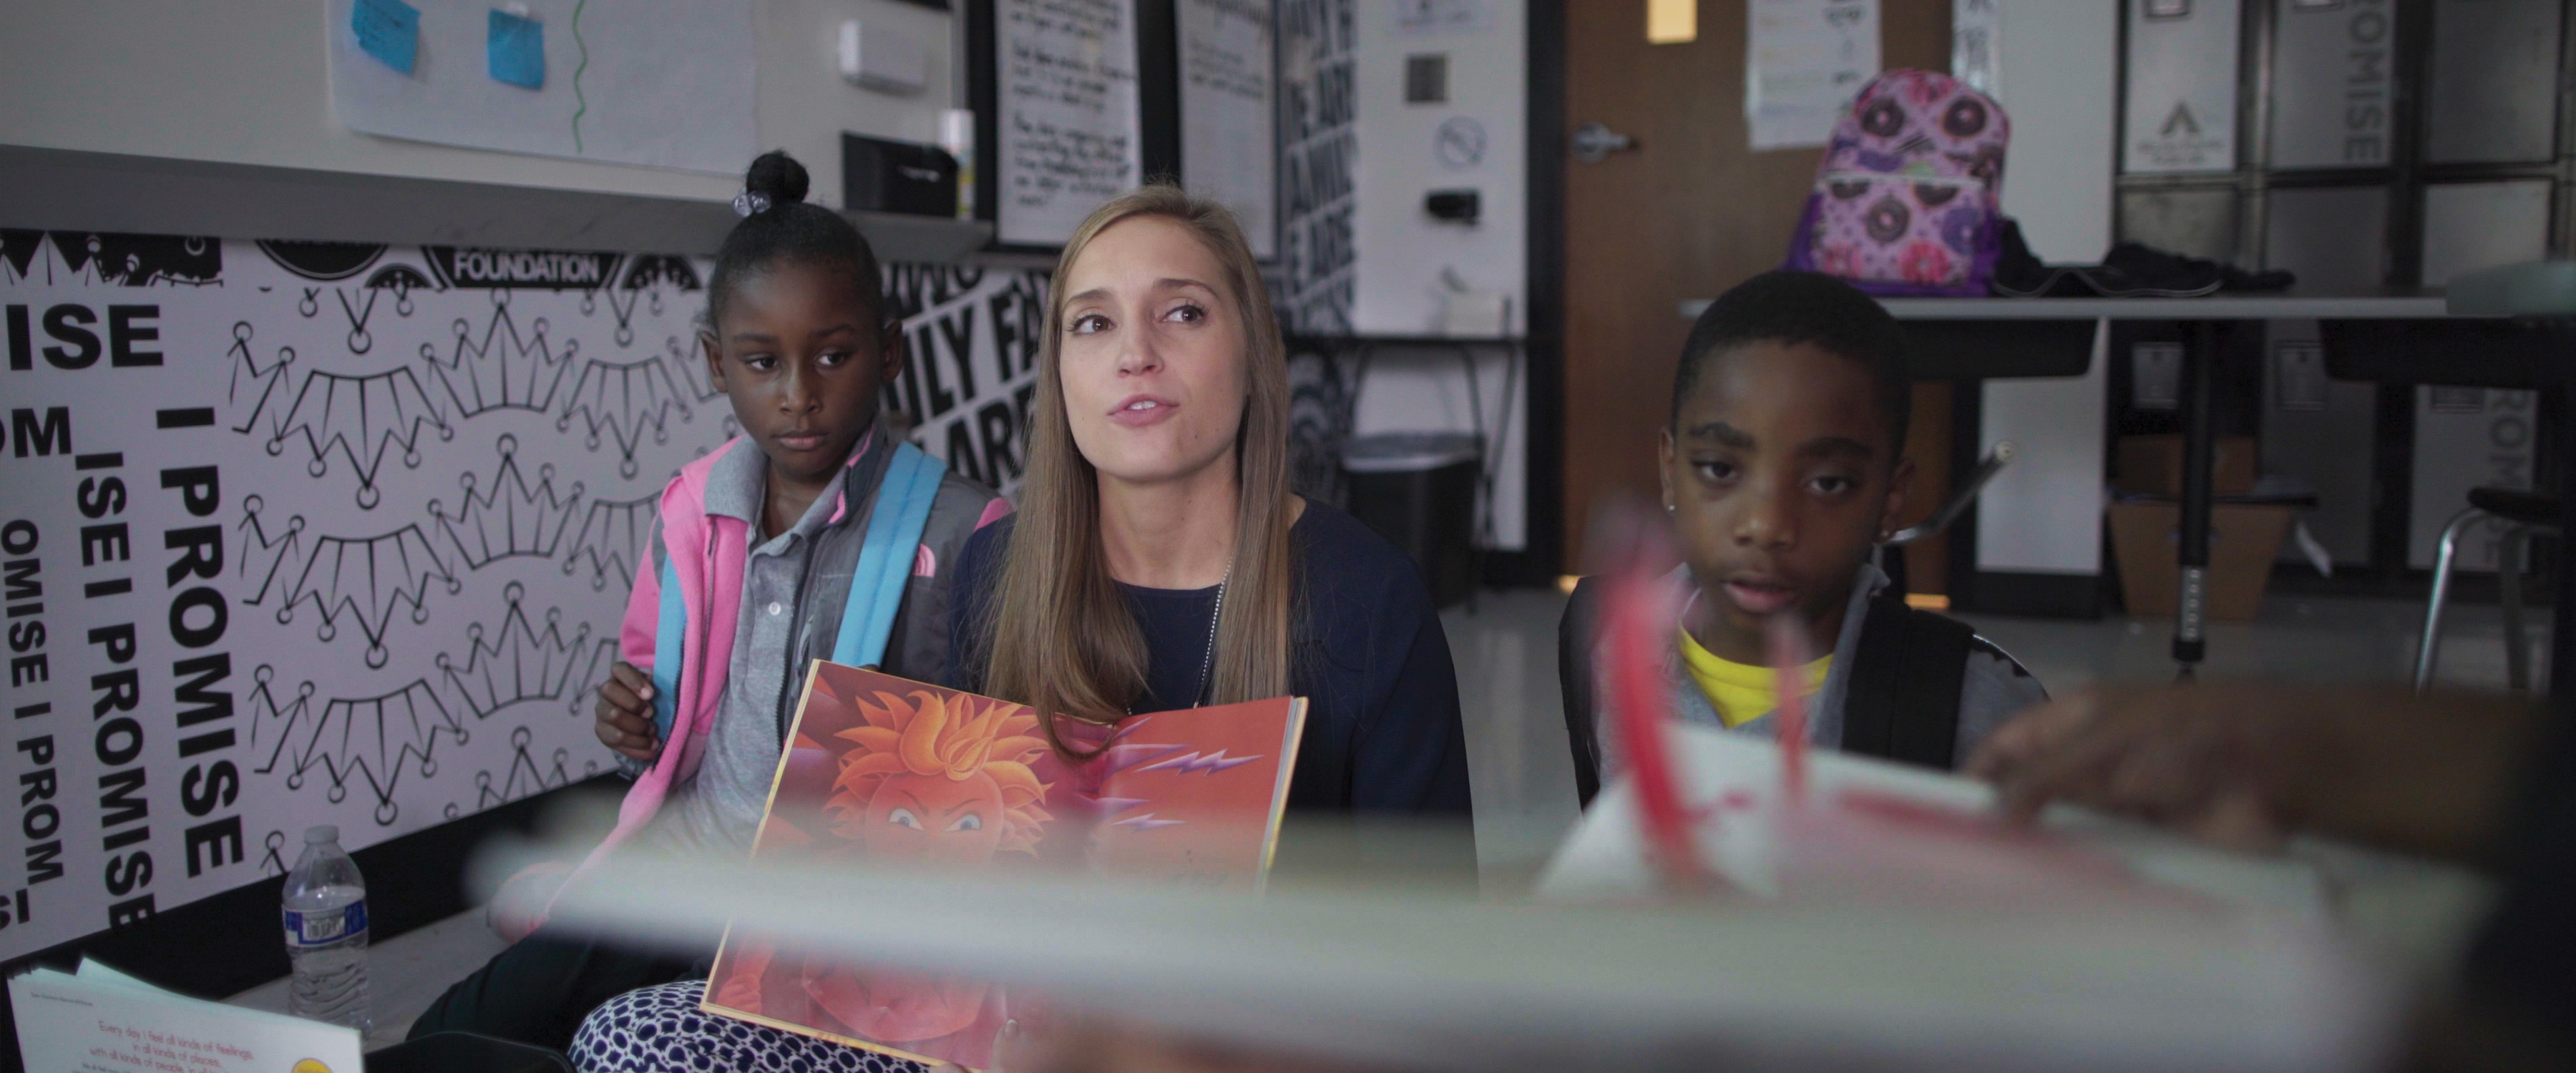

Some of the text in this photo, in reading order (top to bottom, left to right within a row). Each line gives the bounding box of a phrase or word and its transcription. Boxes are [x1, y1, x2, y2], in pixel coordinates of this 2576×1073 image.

[2345, 0, 2388, 161] OMISE
[453, 250, 600, 282] FOUNDATION
[6, 303, 164, 371] ISE
[0, 406, 72, 459] M
[74, 451, 157, 929] ISE I PROMISE
[155, 406, 245, 879] I PROMISE
[0, 519, 64, 886] OMISE I PROM
[98, 1020, 122, 1037] Every
